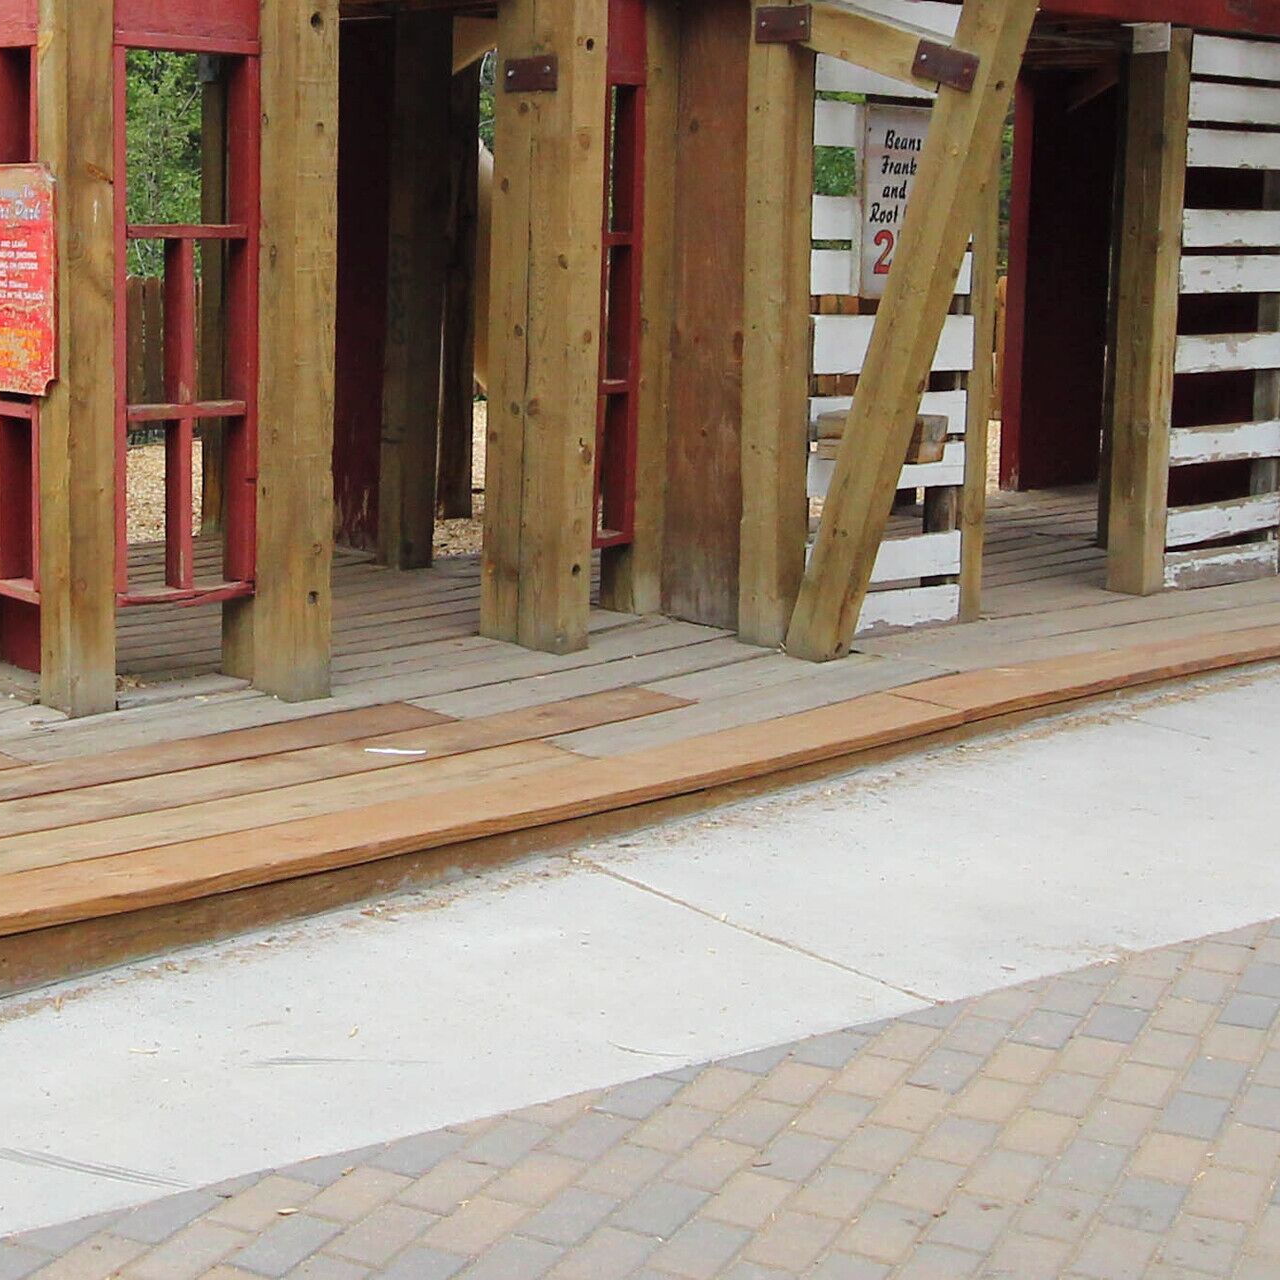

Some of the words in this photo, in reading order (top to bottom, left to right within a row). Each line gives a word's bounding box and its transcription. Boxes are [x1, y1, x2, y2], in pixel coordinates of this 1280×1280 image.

[885, 130, 922, 151] Beans
[882, 180, 907, 199] and
[870, 202, 898, 223] Root
